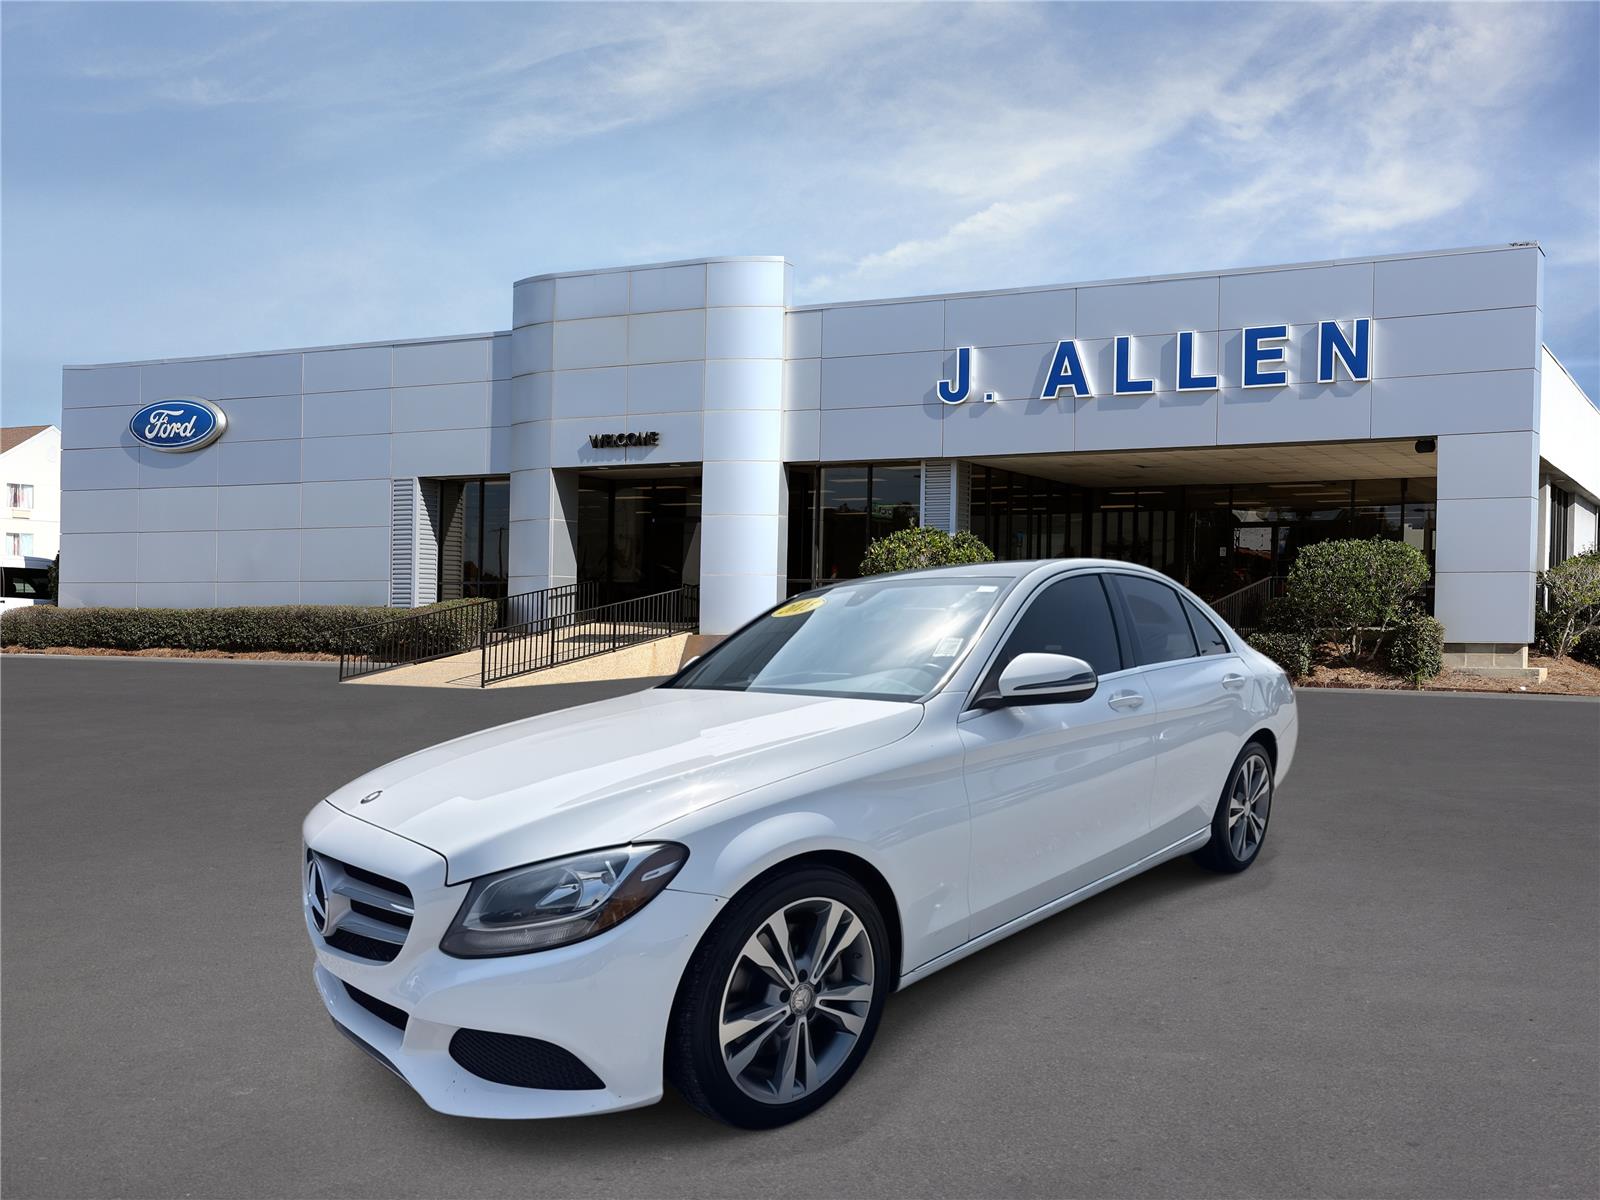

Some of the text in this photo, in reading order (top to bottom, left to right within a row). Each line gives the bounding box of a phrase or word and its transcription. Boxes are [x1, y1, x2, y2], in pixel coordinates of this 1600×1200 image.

[937, 317, 1373, 404] J. ALLEN
[144, 409, 197, 439] Ford
